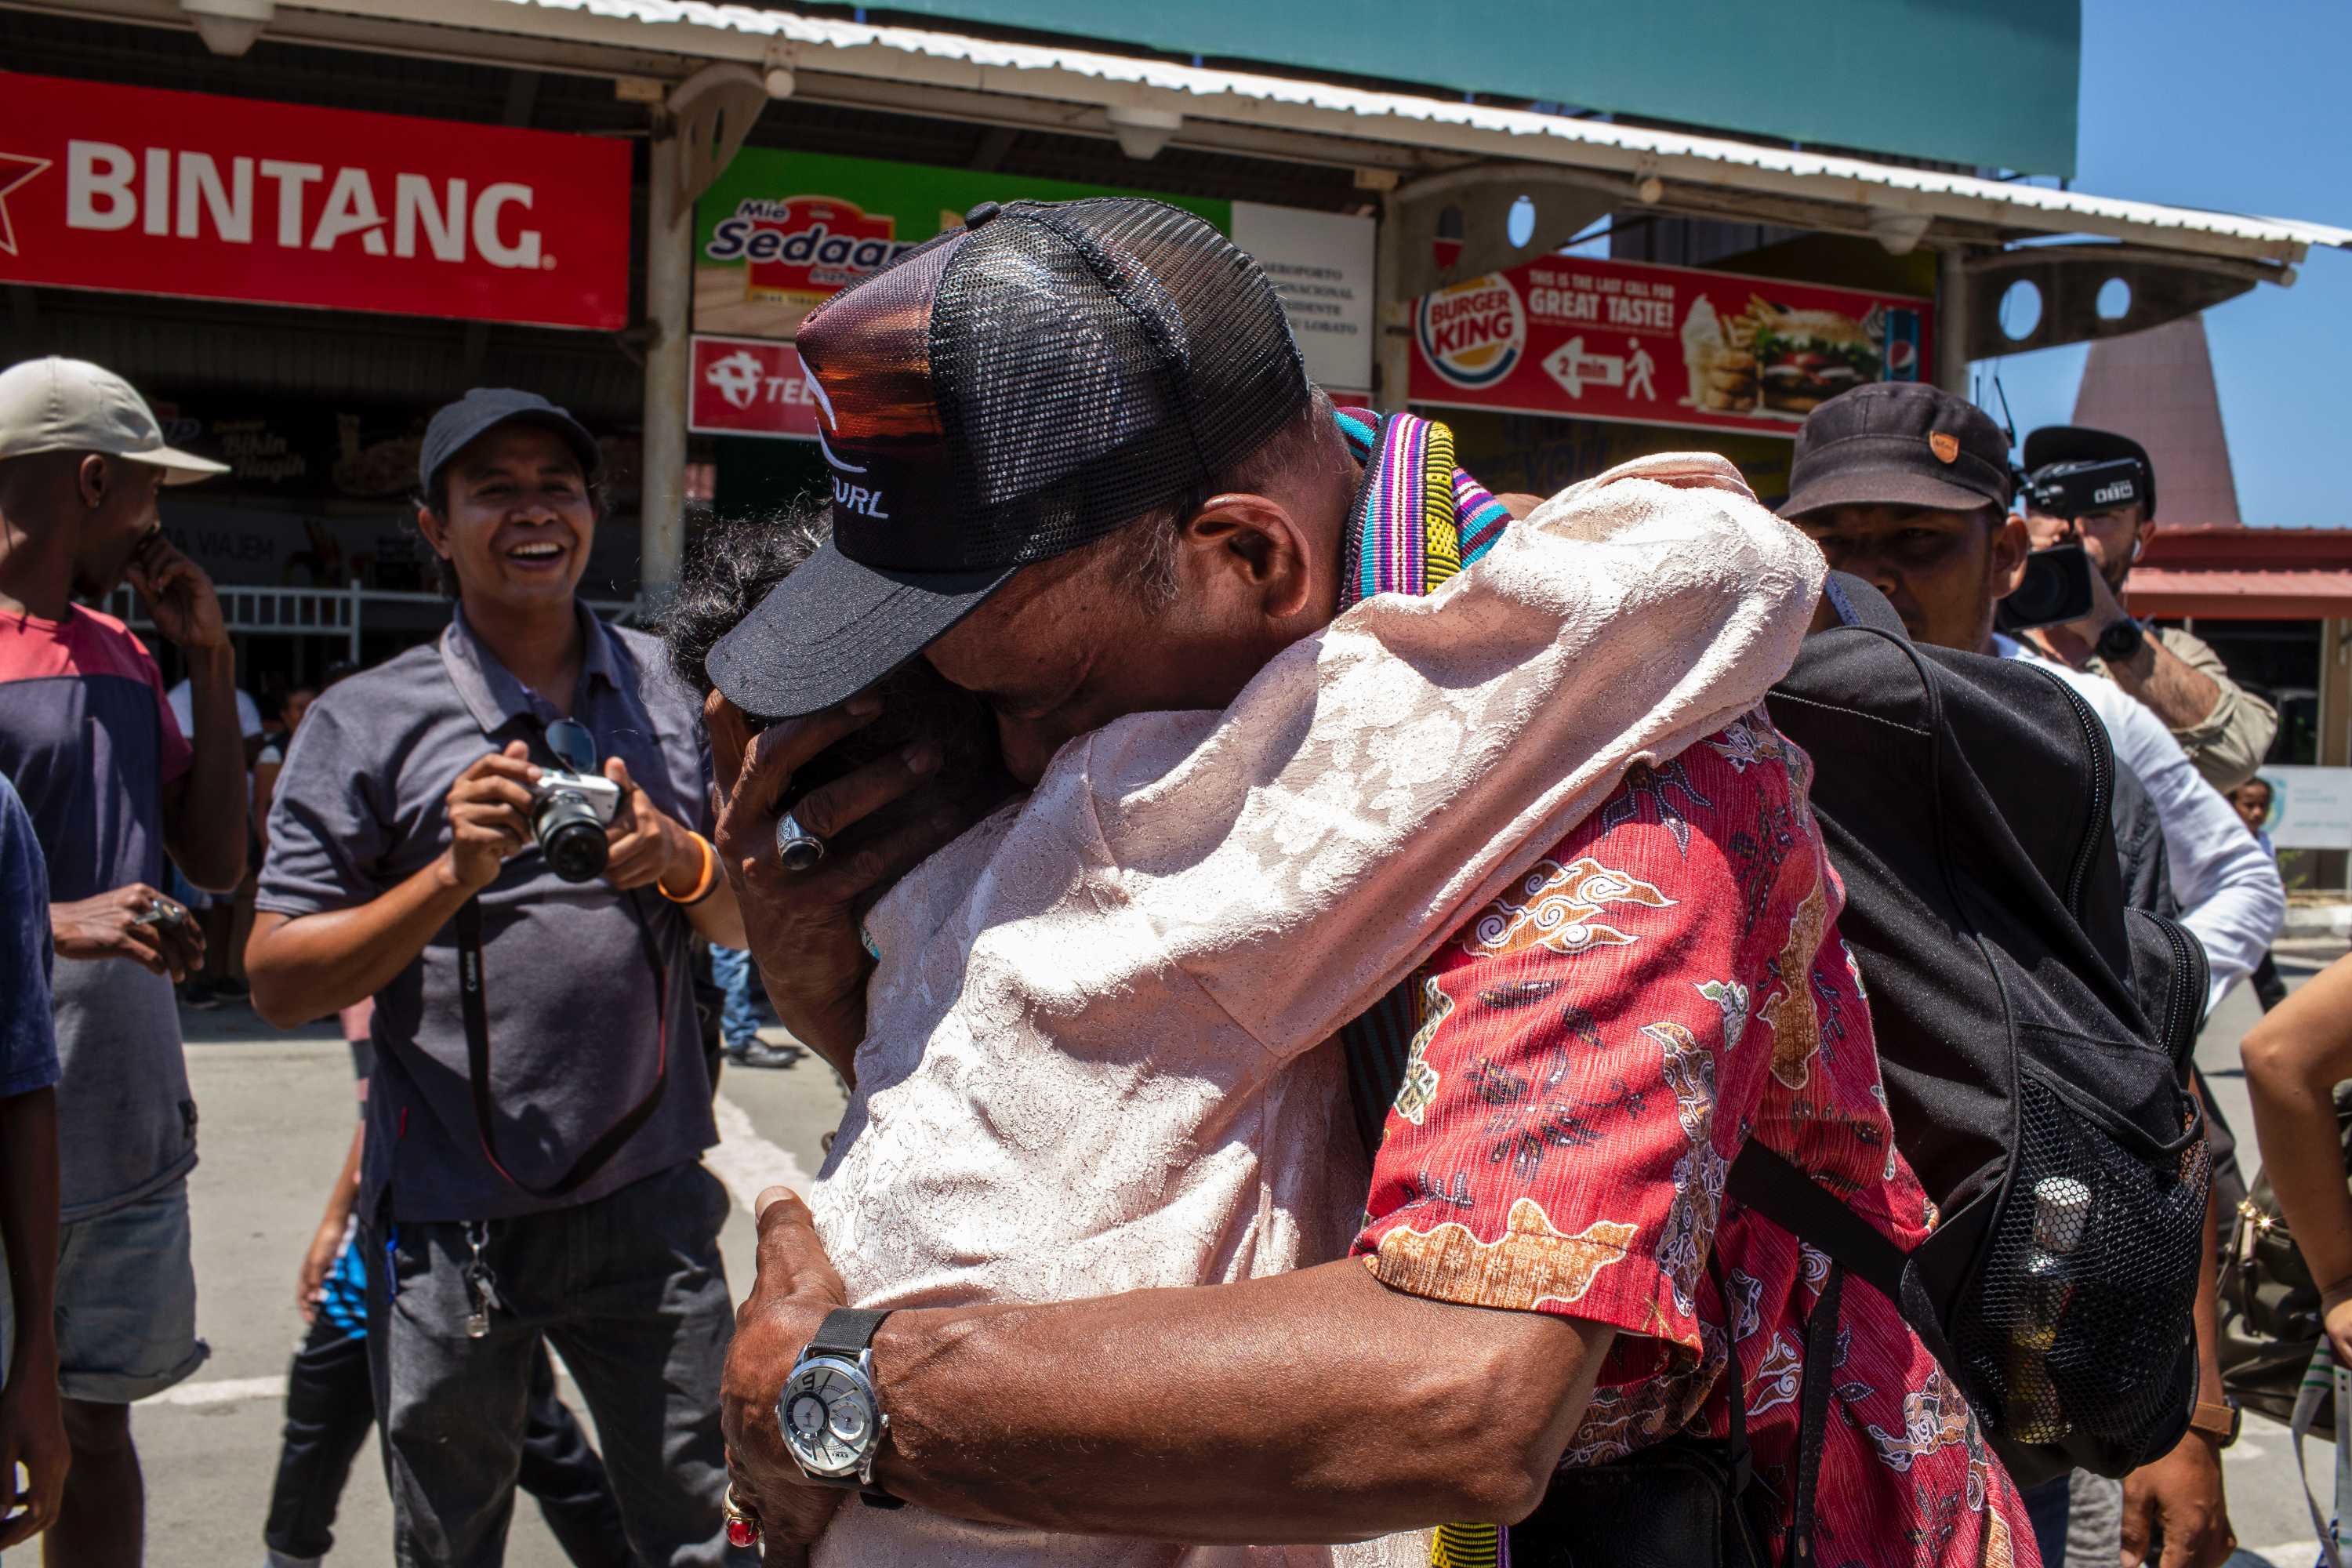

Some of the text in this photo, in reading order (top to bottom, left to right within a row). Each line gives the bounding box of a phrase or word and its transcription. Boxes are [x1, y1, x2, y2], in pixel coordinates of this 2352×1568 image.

[66, 138, 543, 270] BINTANG
[739, 201, 789, 220] Mie
[1529, 269, 1675, 299] THIS IS THE LAST CALL FOR
[1285, 300, 1341, 316] SIDENTE
[1430, 289, 1509, 326] BURGER
[1529, 288, 1600, 320] GREAT
[1606, 296, 1675, 328] TASTE!
[1304, 320, 1357, 334] LOBATO
[1433, 312, 1513, 357] KING
[1558, 357, 1607, 379] 2 min
[832, 475, 889, 519] URL
[196, 528, 274, 563] VIAJEM
